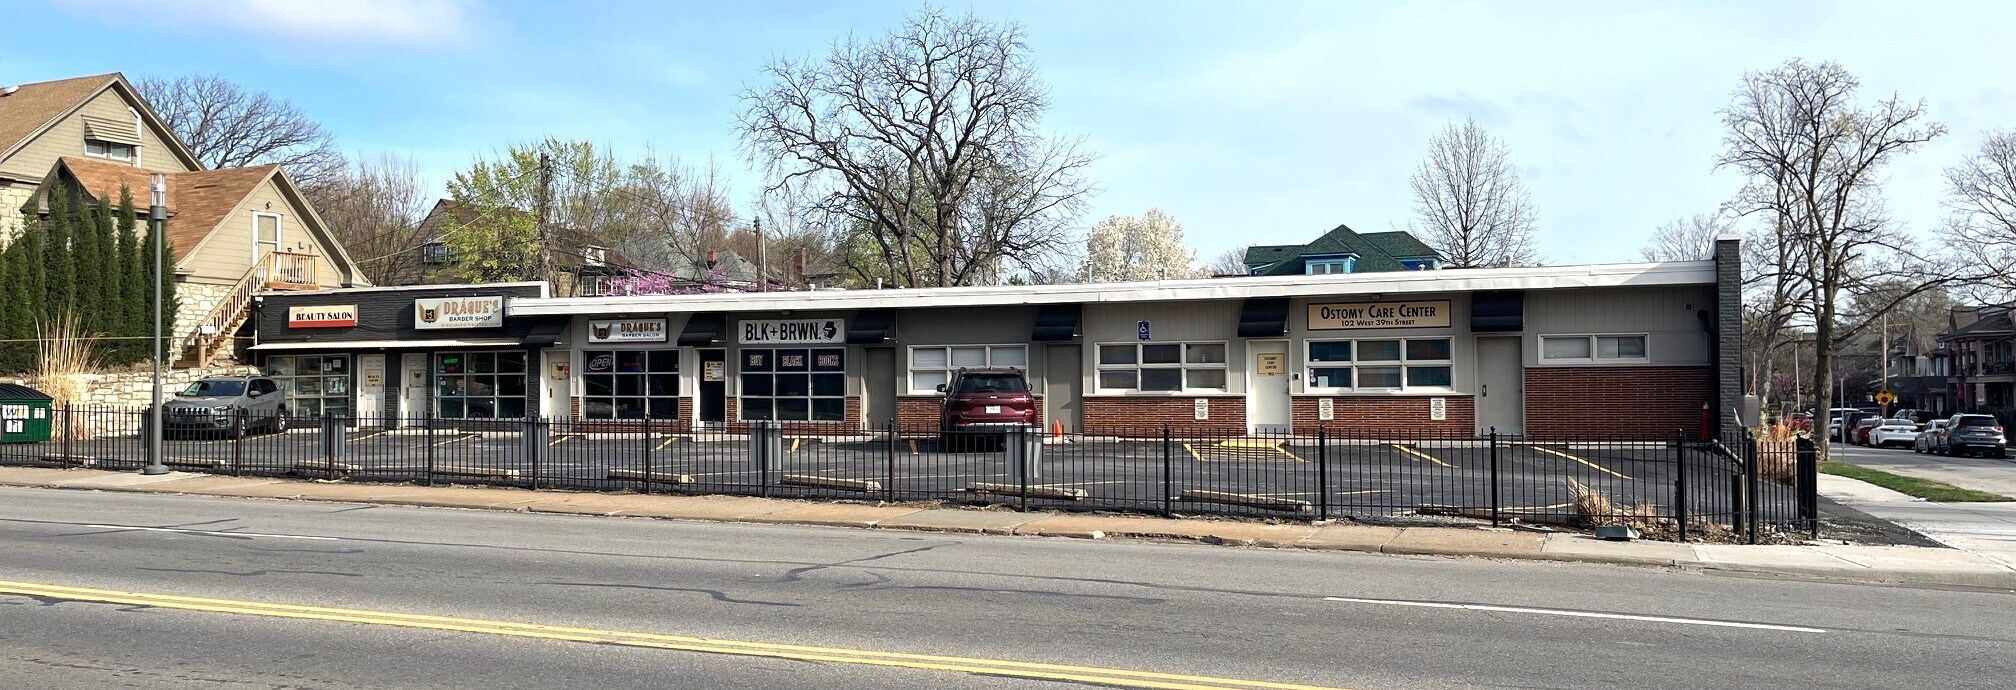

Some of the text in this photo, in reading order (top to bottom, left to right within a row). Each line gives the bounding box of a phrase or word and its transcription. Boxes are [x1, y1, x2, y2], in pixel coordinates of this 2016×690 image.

[296, 311, 352, 321] BEAUTY SALON
[1321, 304, 1436, 320] OSTOMY CARE CENTER
[1394, 318, 1415, 326] STREET
[591, 358, 612, 368] OPEN
[749, 354, 839, 367] BUY BLACK BOOKS
